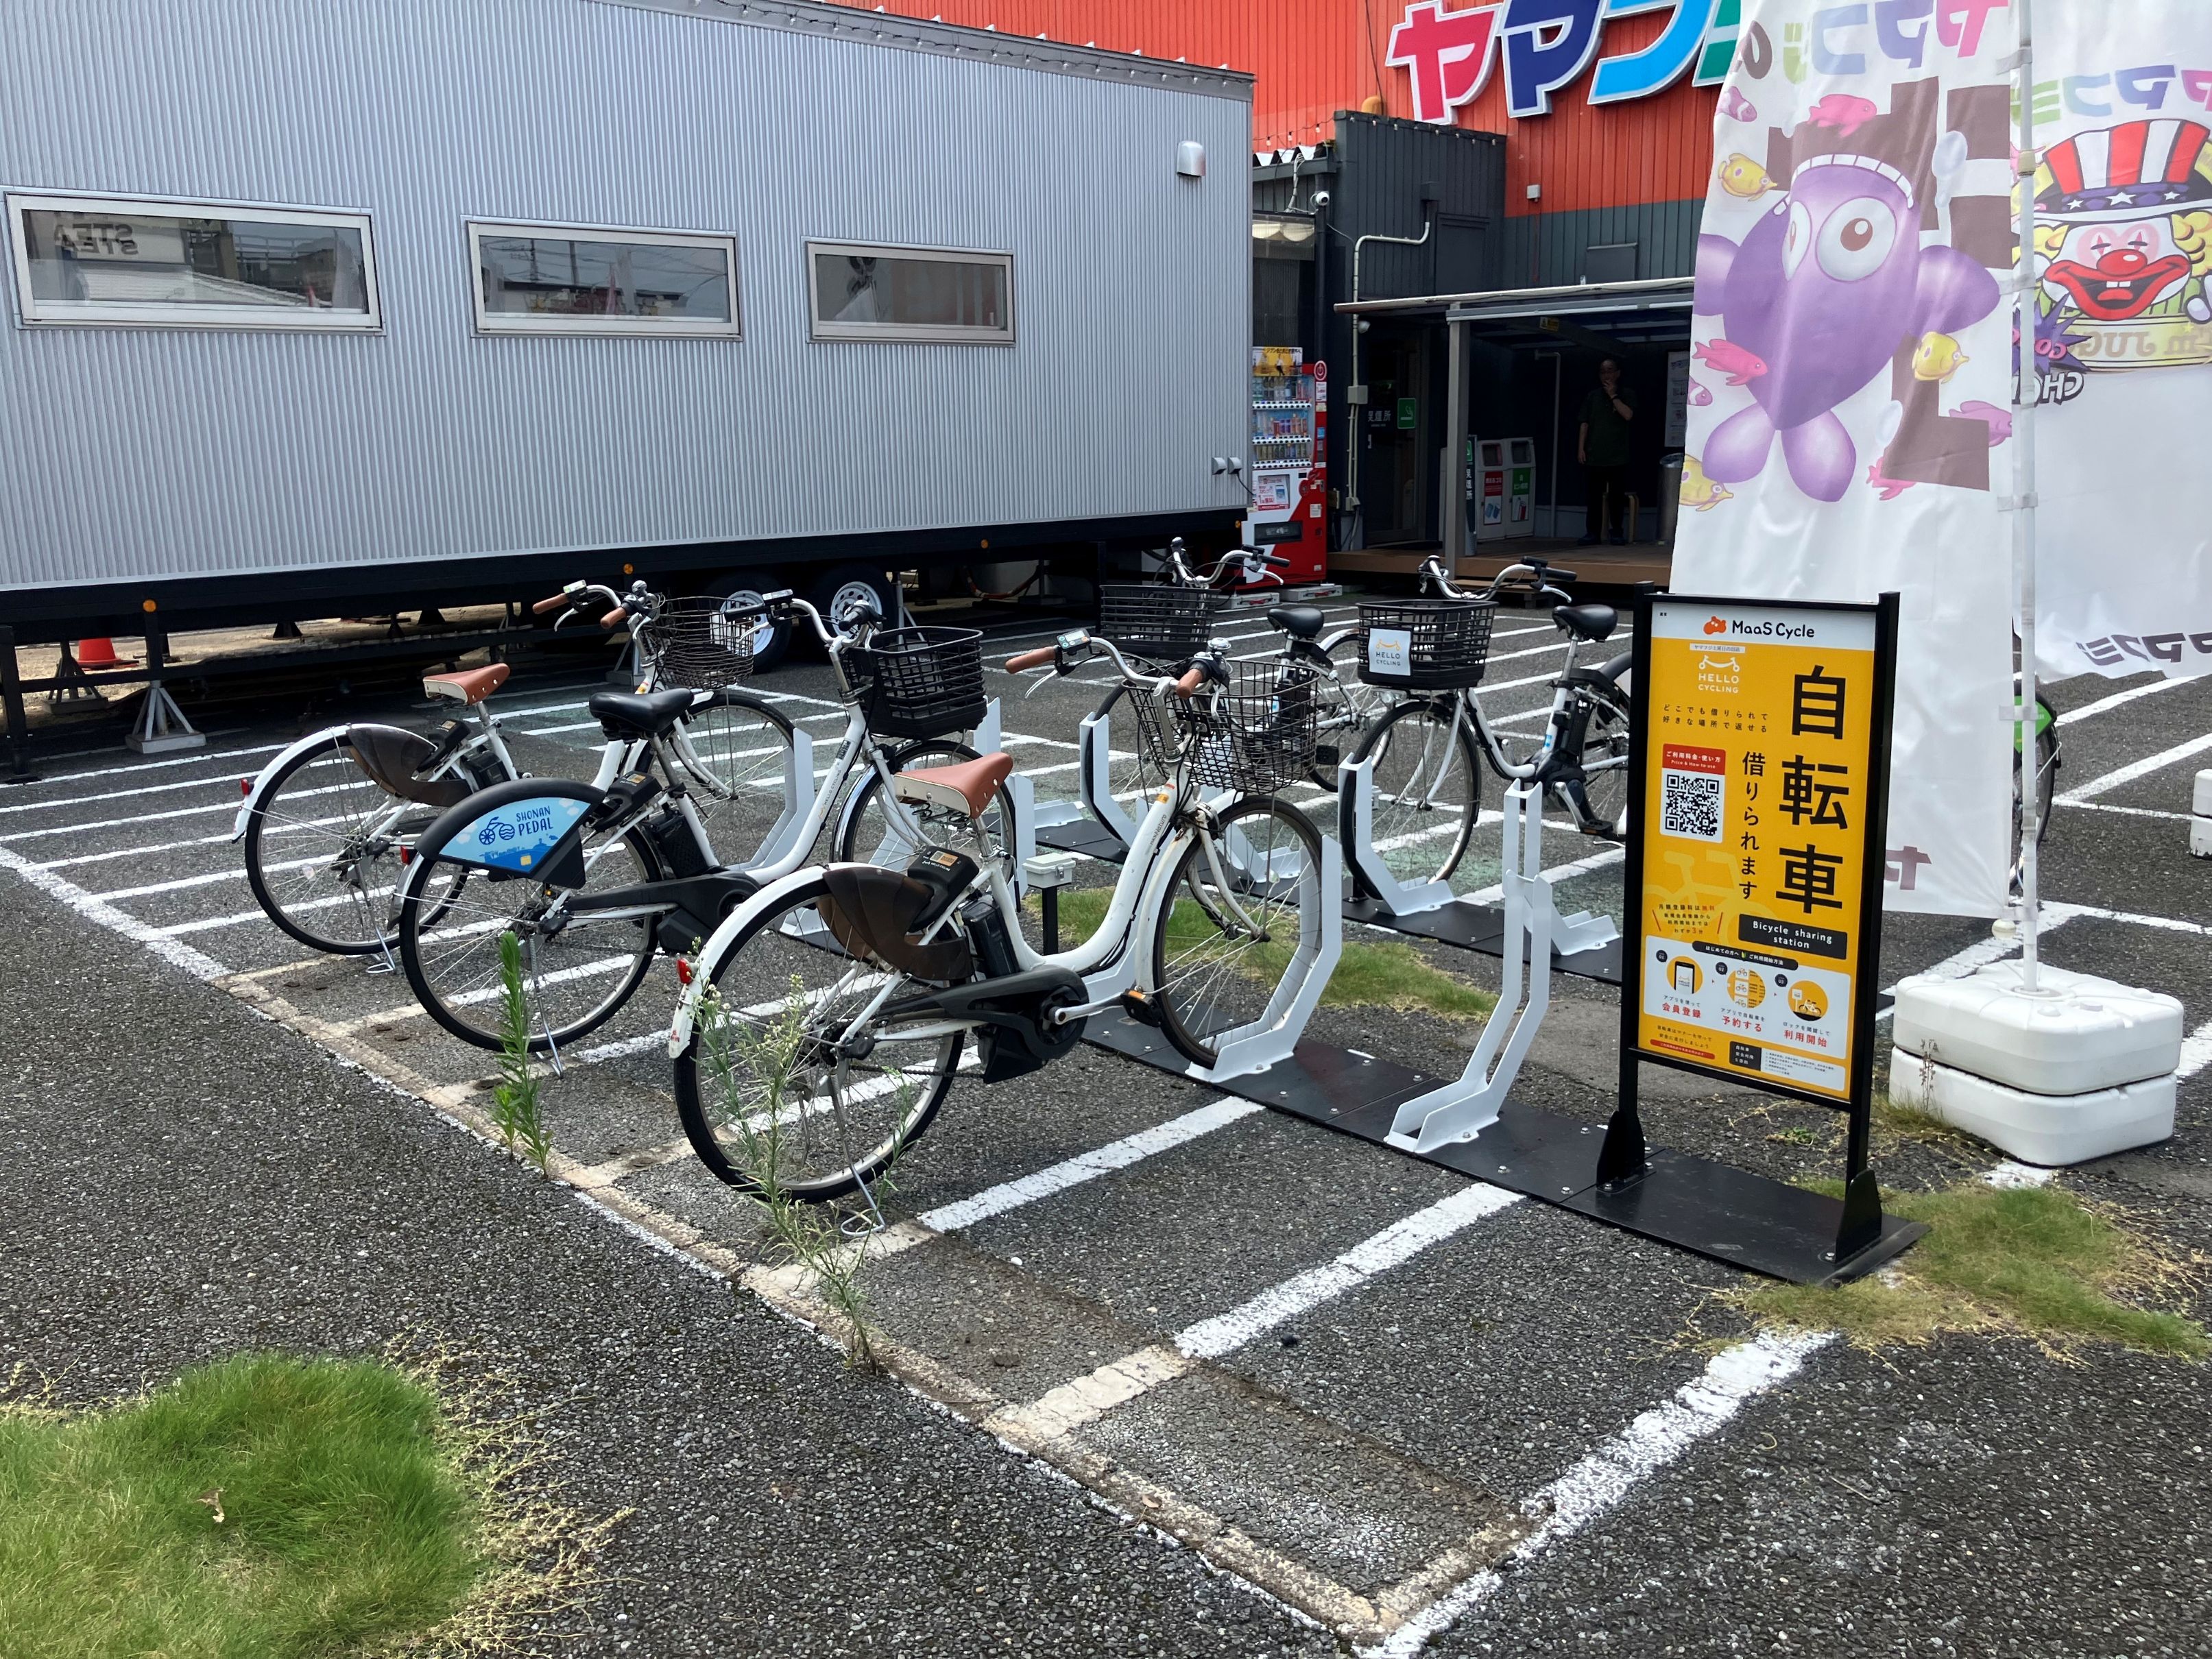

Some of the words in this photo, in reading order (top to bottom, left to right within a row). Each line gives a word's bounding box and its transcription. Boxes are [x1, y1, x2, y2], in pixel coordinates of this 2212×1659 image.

[1732, 620, 1772, 635] MaaS
[1776, 623, 1814, 639] Cycle
[1698, 673, 1739, 683] HELLO
[1698, 684, 1738, 694] CYCLING
[1663, 704, 1768, 720] どこでも借りられて
[1663, 716, 1767, 733] 好きな場所で返せる
[1666, 751, 1721, 763] ご利用料金・使い方
[824, 789, 832, 806] HELLO
[832, 770, 841, 789] CYCLING
[1776, 664, 1850, 914] 自転車
[516, 806, 551, 822] SHONAN
[518, 817, 553, 836] PEDAL
[1739, 751, 1766, 900] 借りられます
[1753, 921, 1788, 934] Bicycle
[1794, 928, 1833, 945] sharing
[1773, 936, 1810, 949] station
[1705, 945, 1740, 956] はじめての方へ
[1749, 954, 1783, 965] ご利用開始方法
[1662, 1002, 1701, 1018] 会員登録
[1720, 1008, 1766, 1021] アプリで自転車を
[1722, 1015, 1762, 1032] 予約する
[1783, 1030, 1827, 1048] 利用開始
